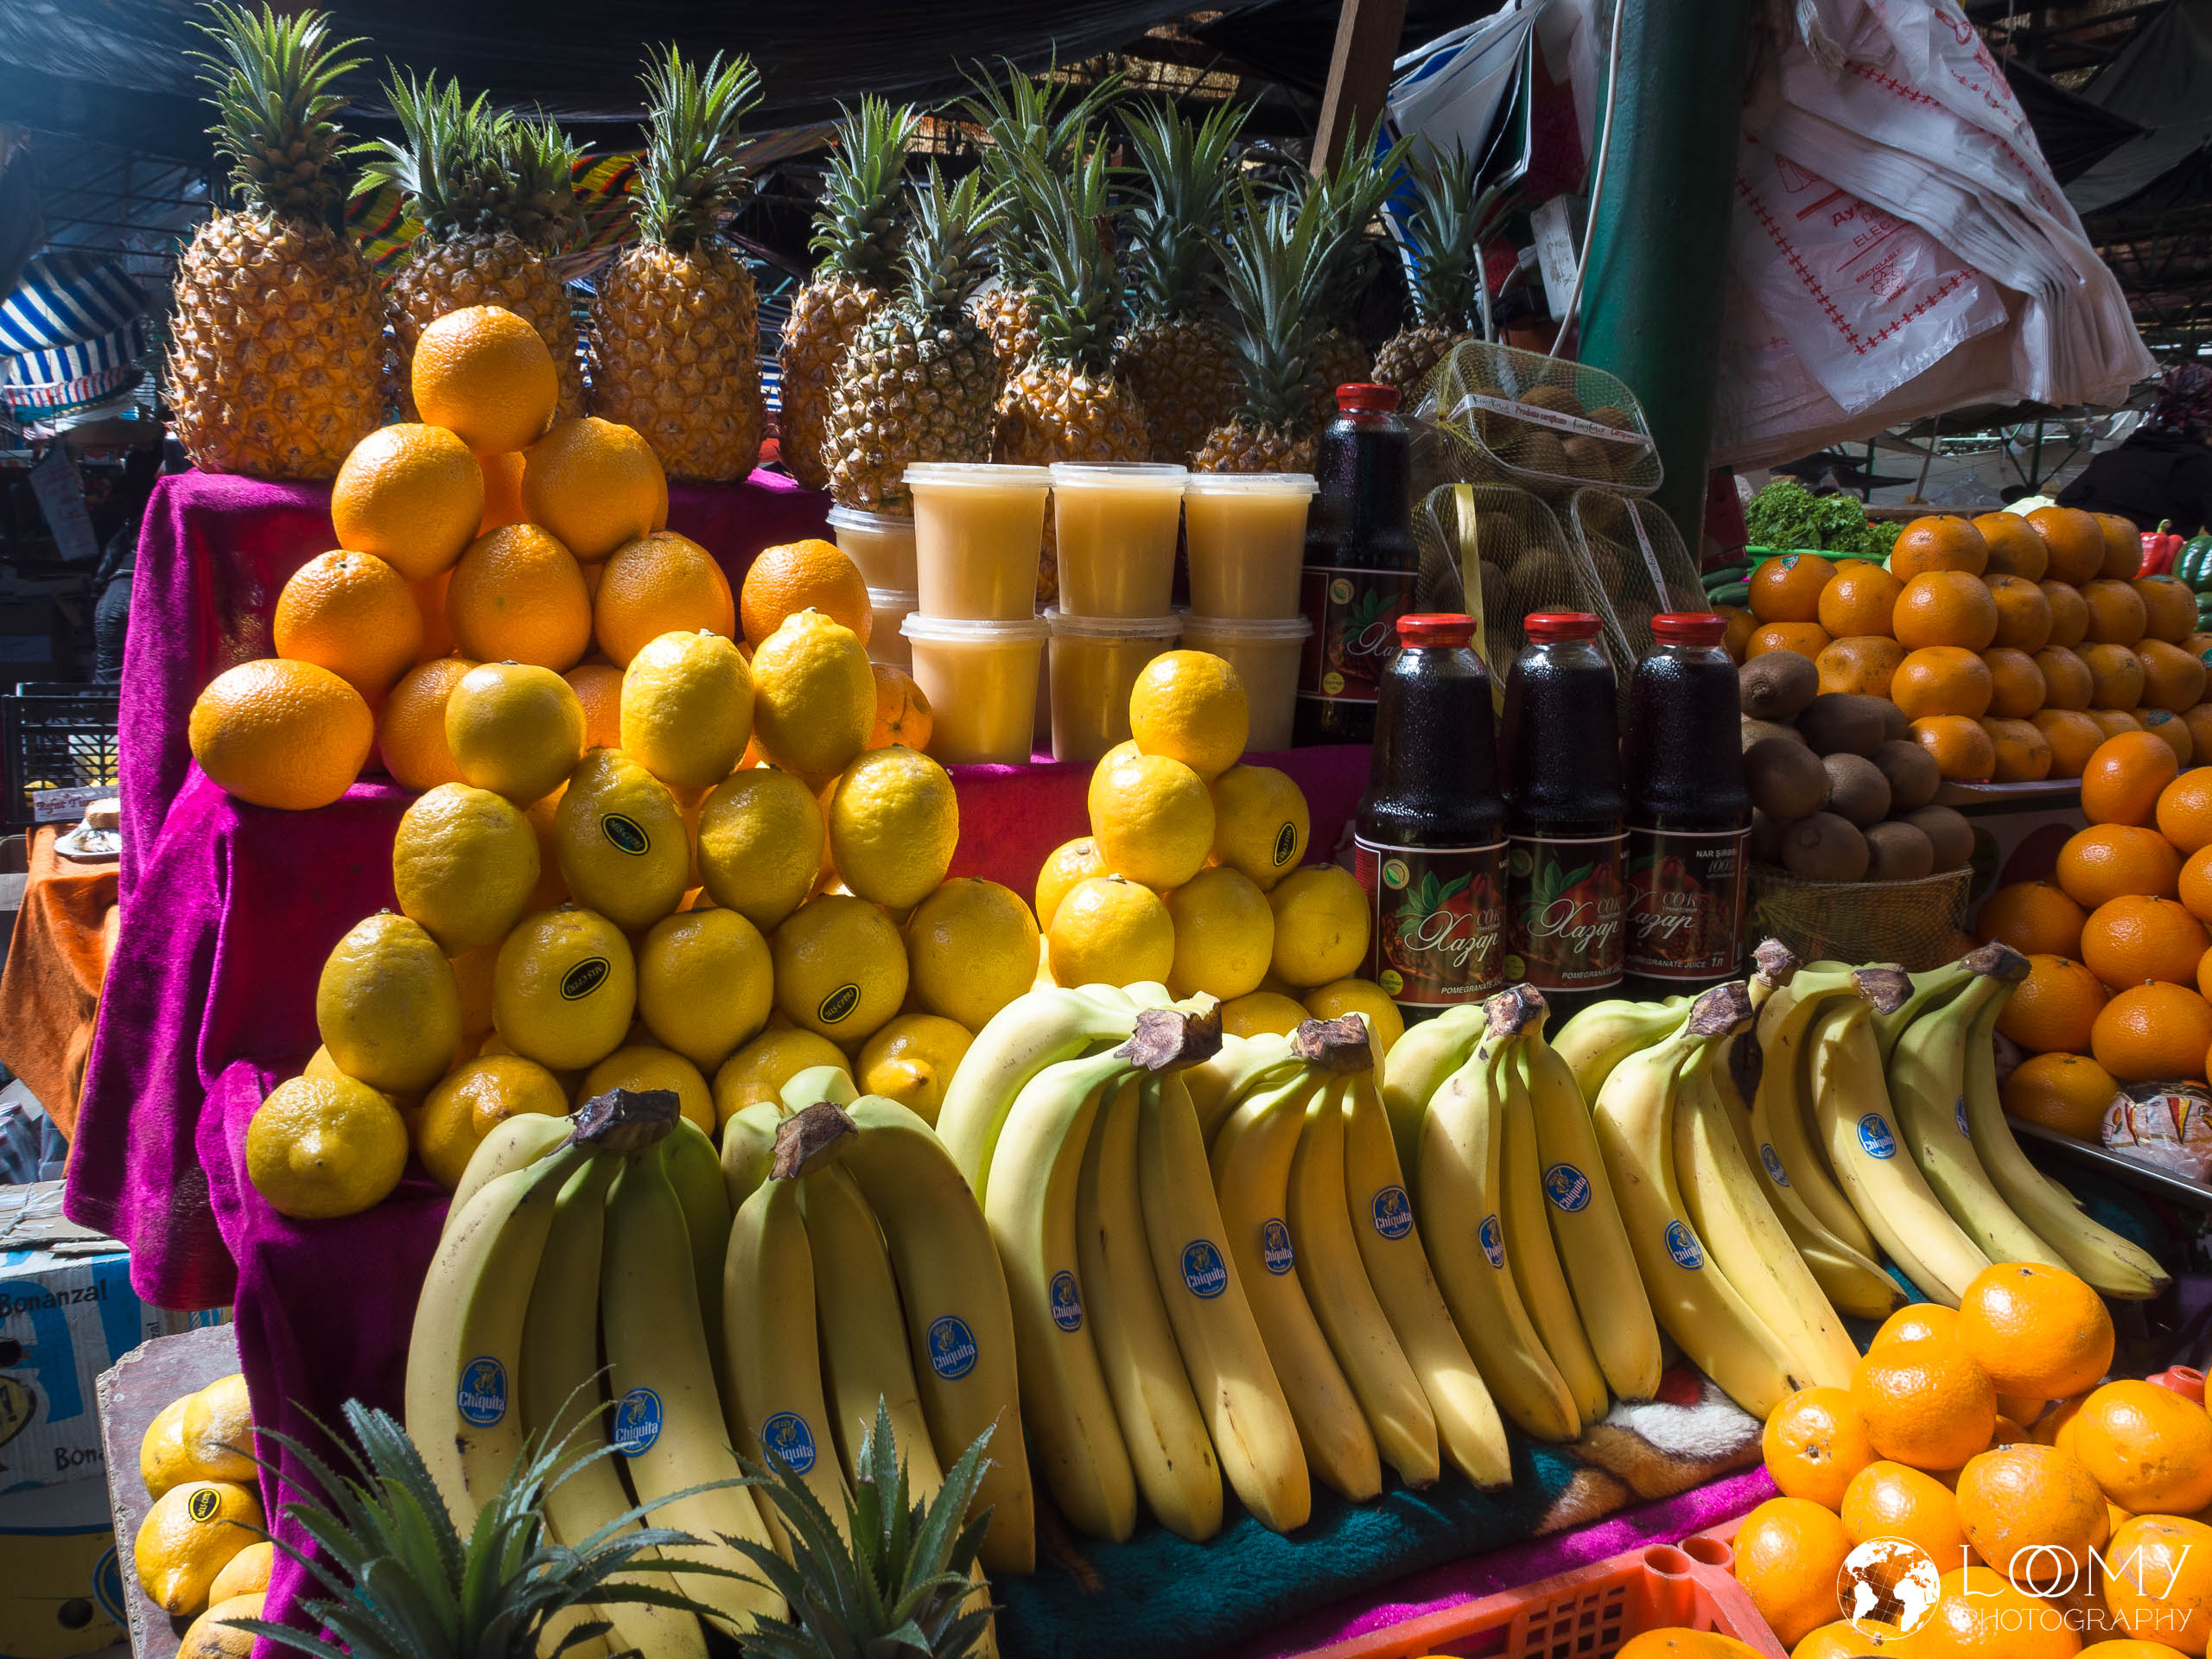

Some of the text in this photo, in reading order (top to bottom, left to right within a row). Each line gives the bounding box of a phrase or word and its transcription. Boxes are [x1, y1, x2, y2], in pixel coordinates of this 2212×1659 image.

[1695, 849, 1713, 858] NAR
[1440, 981, 1493, 995] POMEGRANATE
[1558, 1176, 1587, 1210] Chiquita
[1375, 1211, 1412, 1230] Chiquita
[1185, 1267, 1226, 1288] Chiquita
[0, 1278, 106, 1319] Bonanza!
[932, 1344, 976, 1370] Chiquita
[458, 1390, 505, 1412] Chiquita
[615, 1421, 658, 1442] Chiquita
